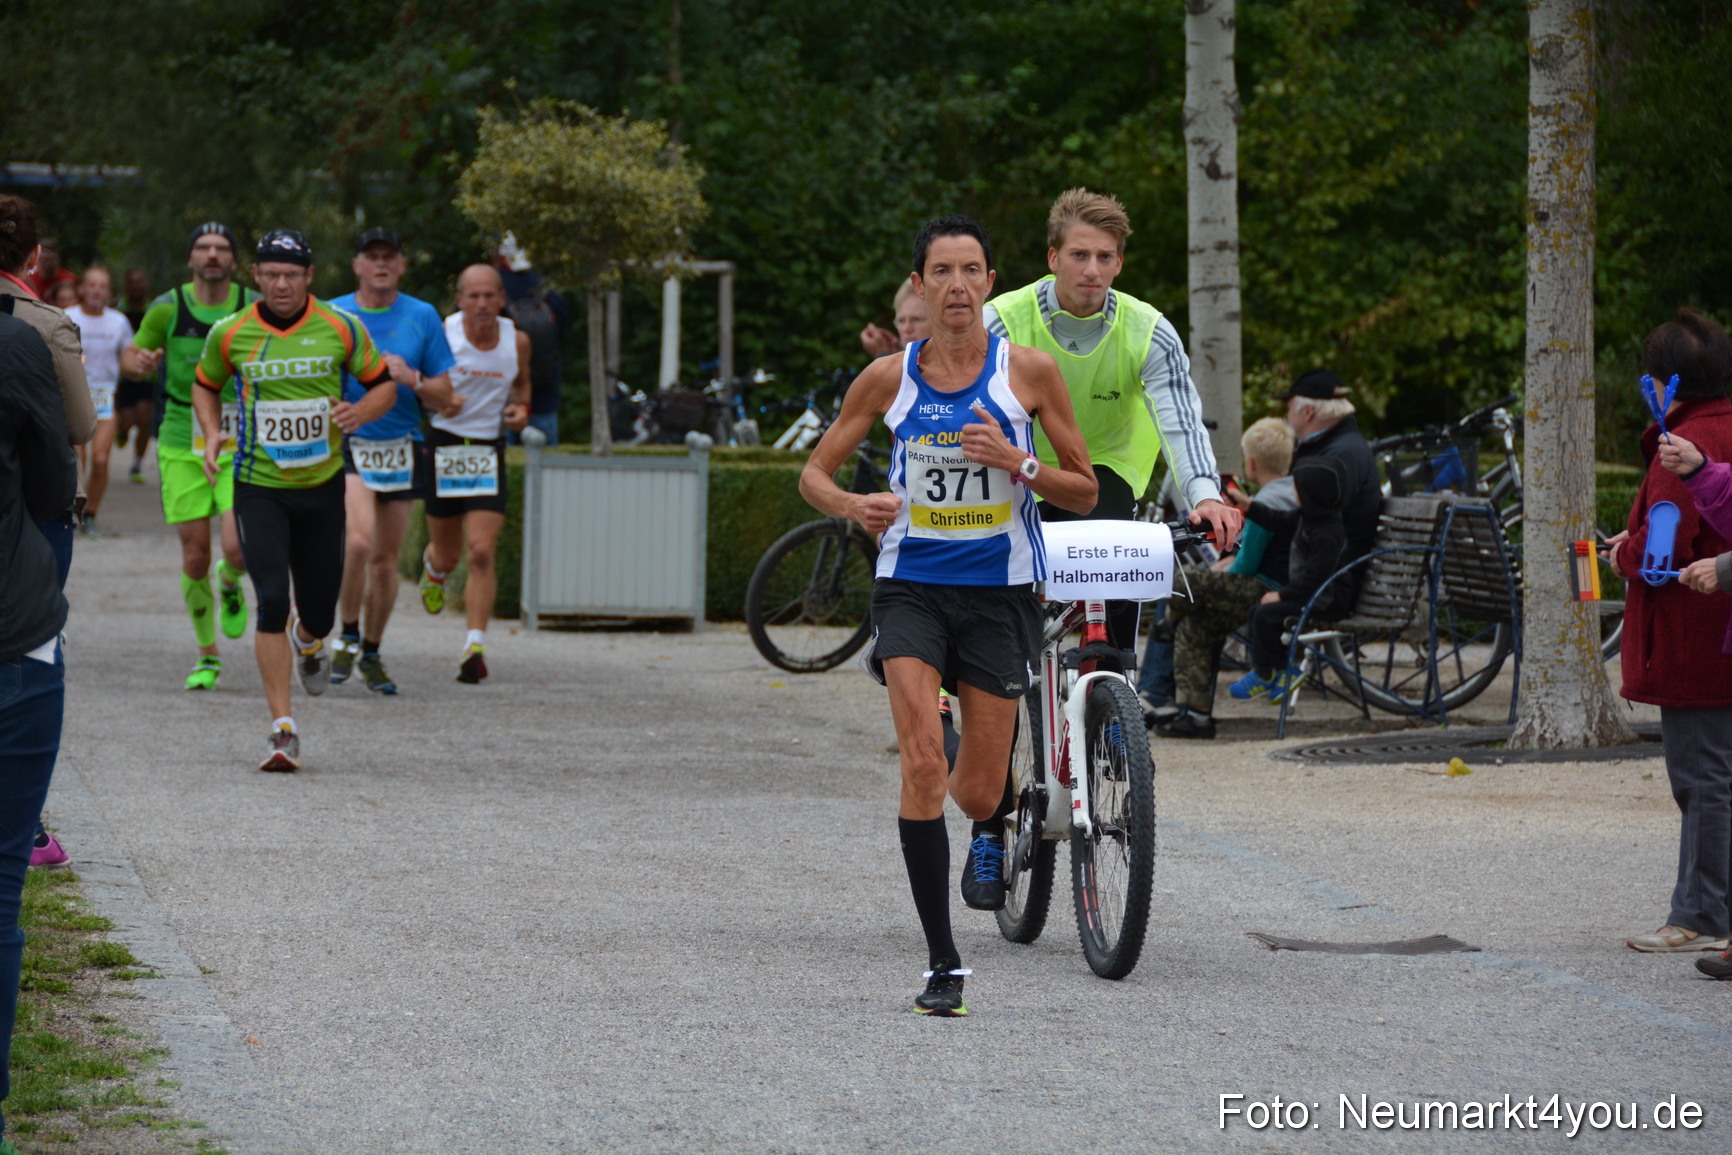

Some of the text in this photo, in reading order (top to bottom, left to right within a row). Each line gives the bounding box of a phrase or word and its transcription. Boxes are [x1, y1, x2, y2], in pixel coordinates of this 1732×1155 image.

[242, 356, 333, 382] BOCK
[919, 403, 954, 414] HEITEC
[265, 414, 323, 442] 2809
[276, 447, 313, 460] Thomas
[359, 448, 407, 471] 2024
[908, 450, 939, 464] PARTL
[925, 466, 990, 503] 371
[930, 511, 993, 527] Christine
[1067, 545, 1149, 560] Erste Frau
[1053, 569, 1164, 584] Halbmarathon
